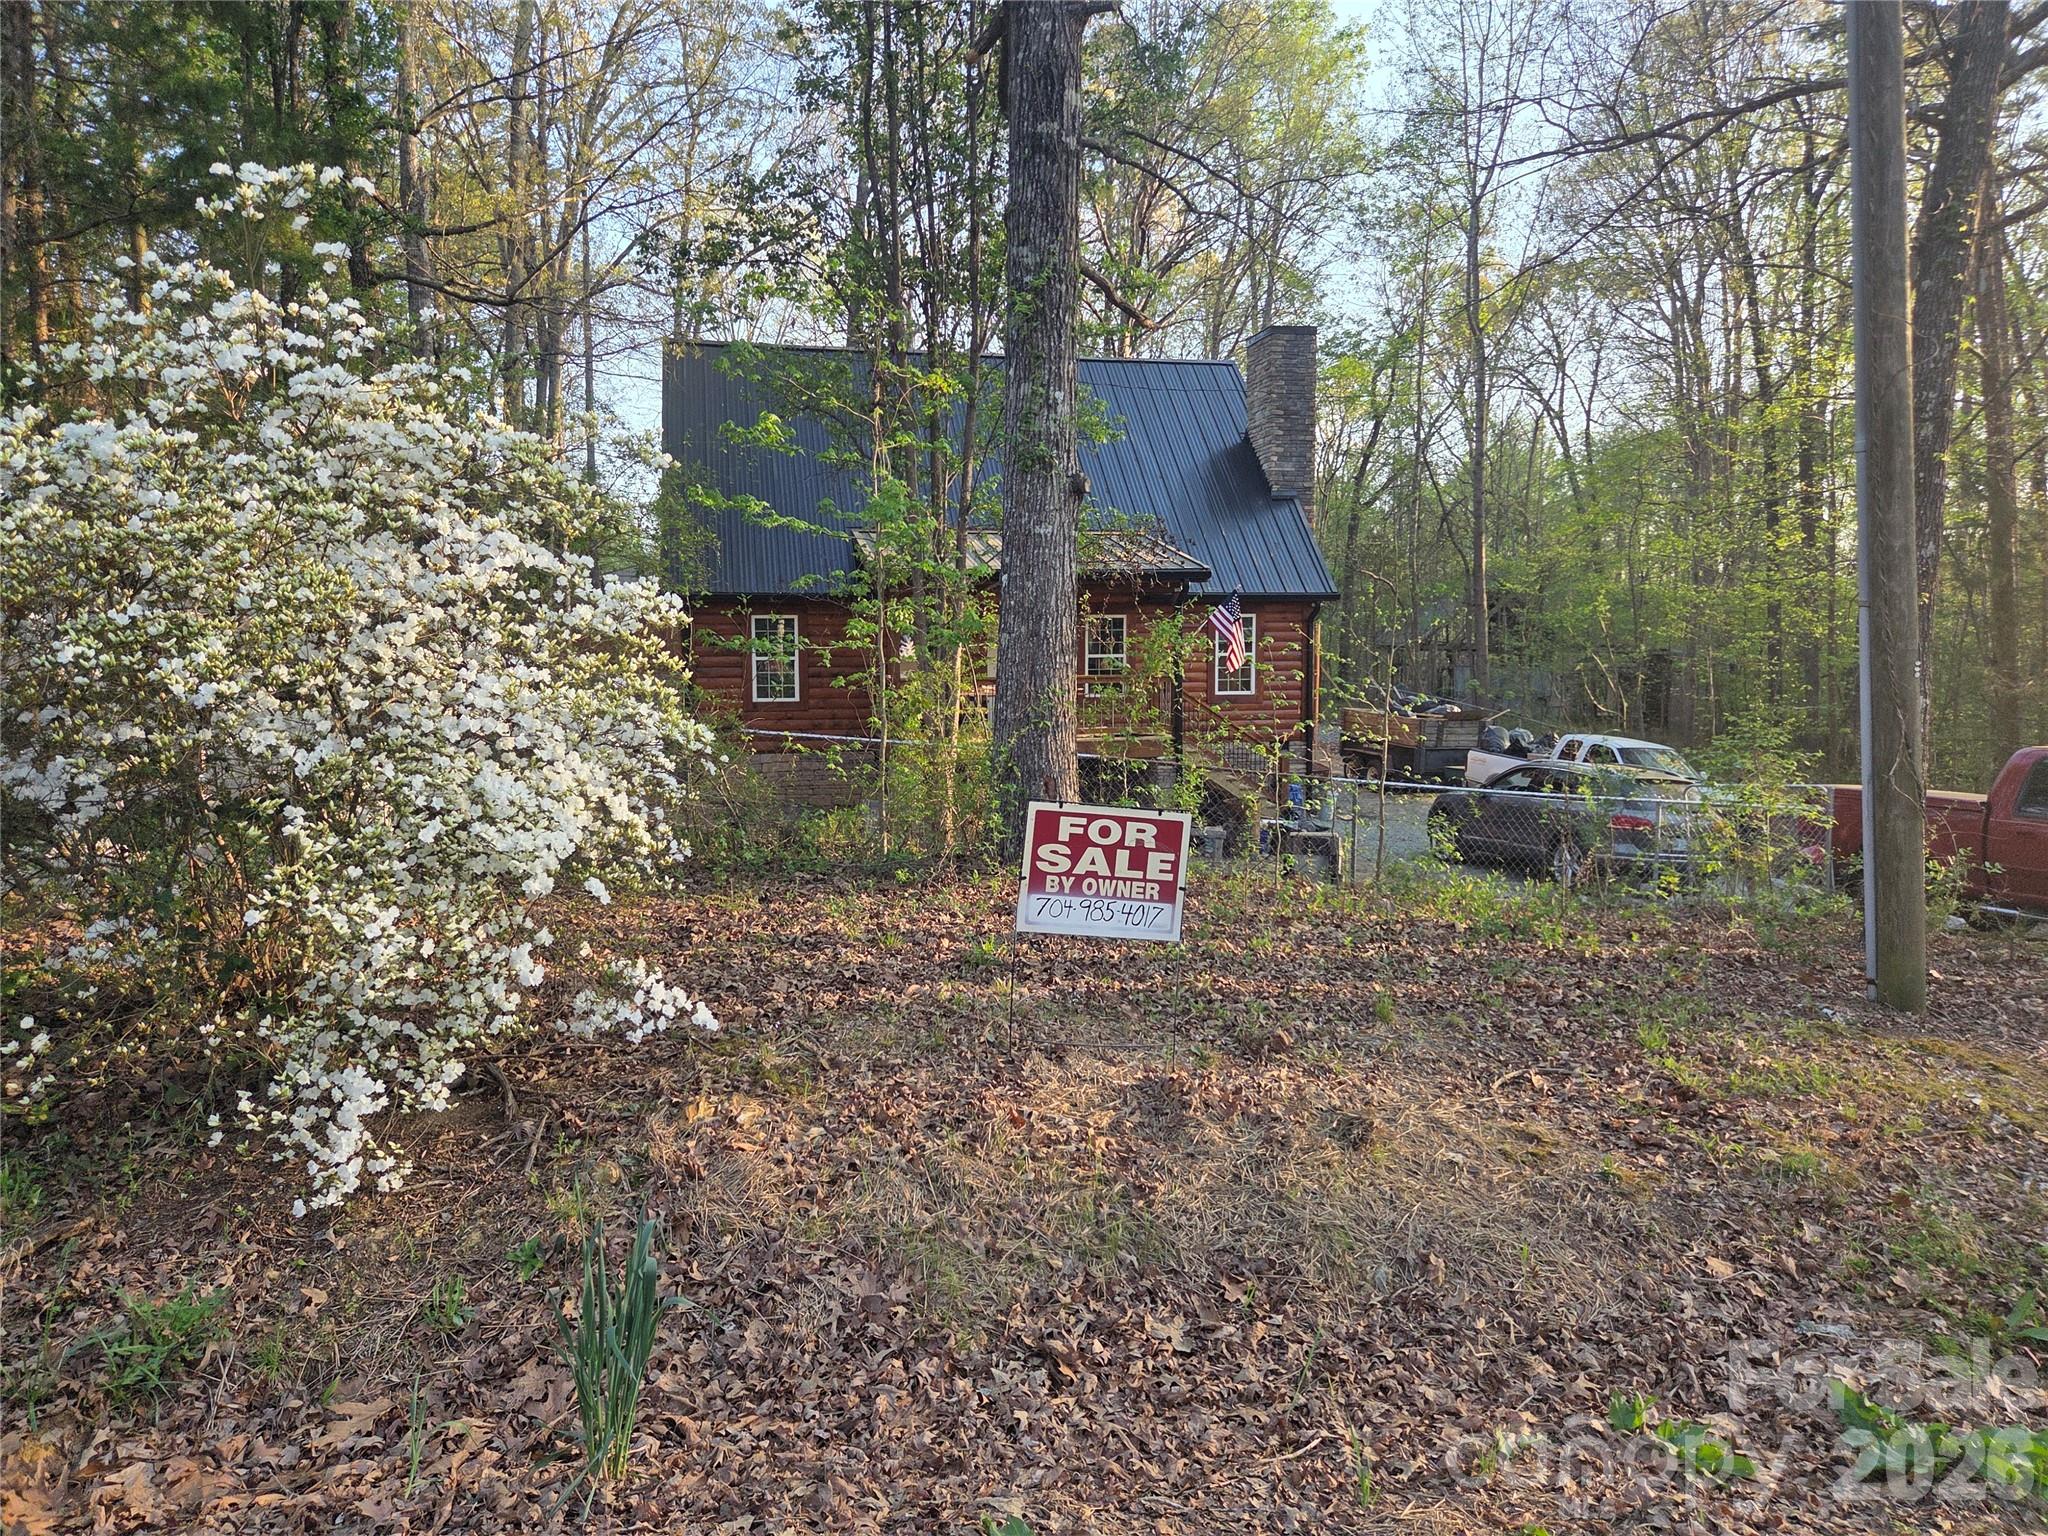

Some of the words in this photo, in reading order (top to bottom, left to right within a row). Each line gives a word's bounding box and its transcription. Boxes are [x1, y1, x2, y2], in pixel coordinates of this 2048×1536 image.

[1058, 816, 1157, 849] FOR
[1036, 844, 1176, 881] SALE
[1045, 875, 1076, 894] BY
[1082, 877, 1160, 900] OWNER
